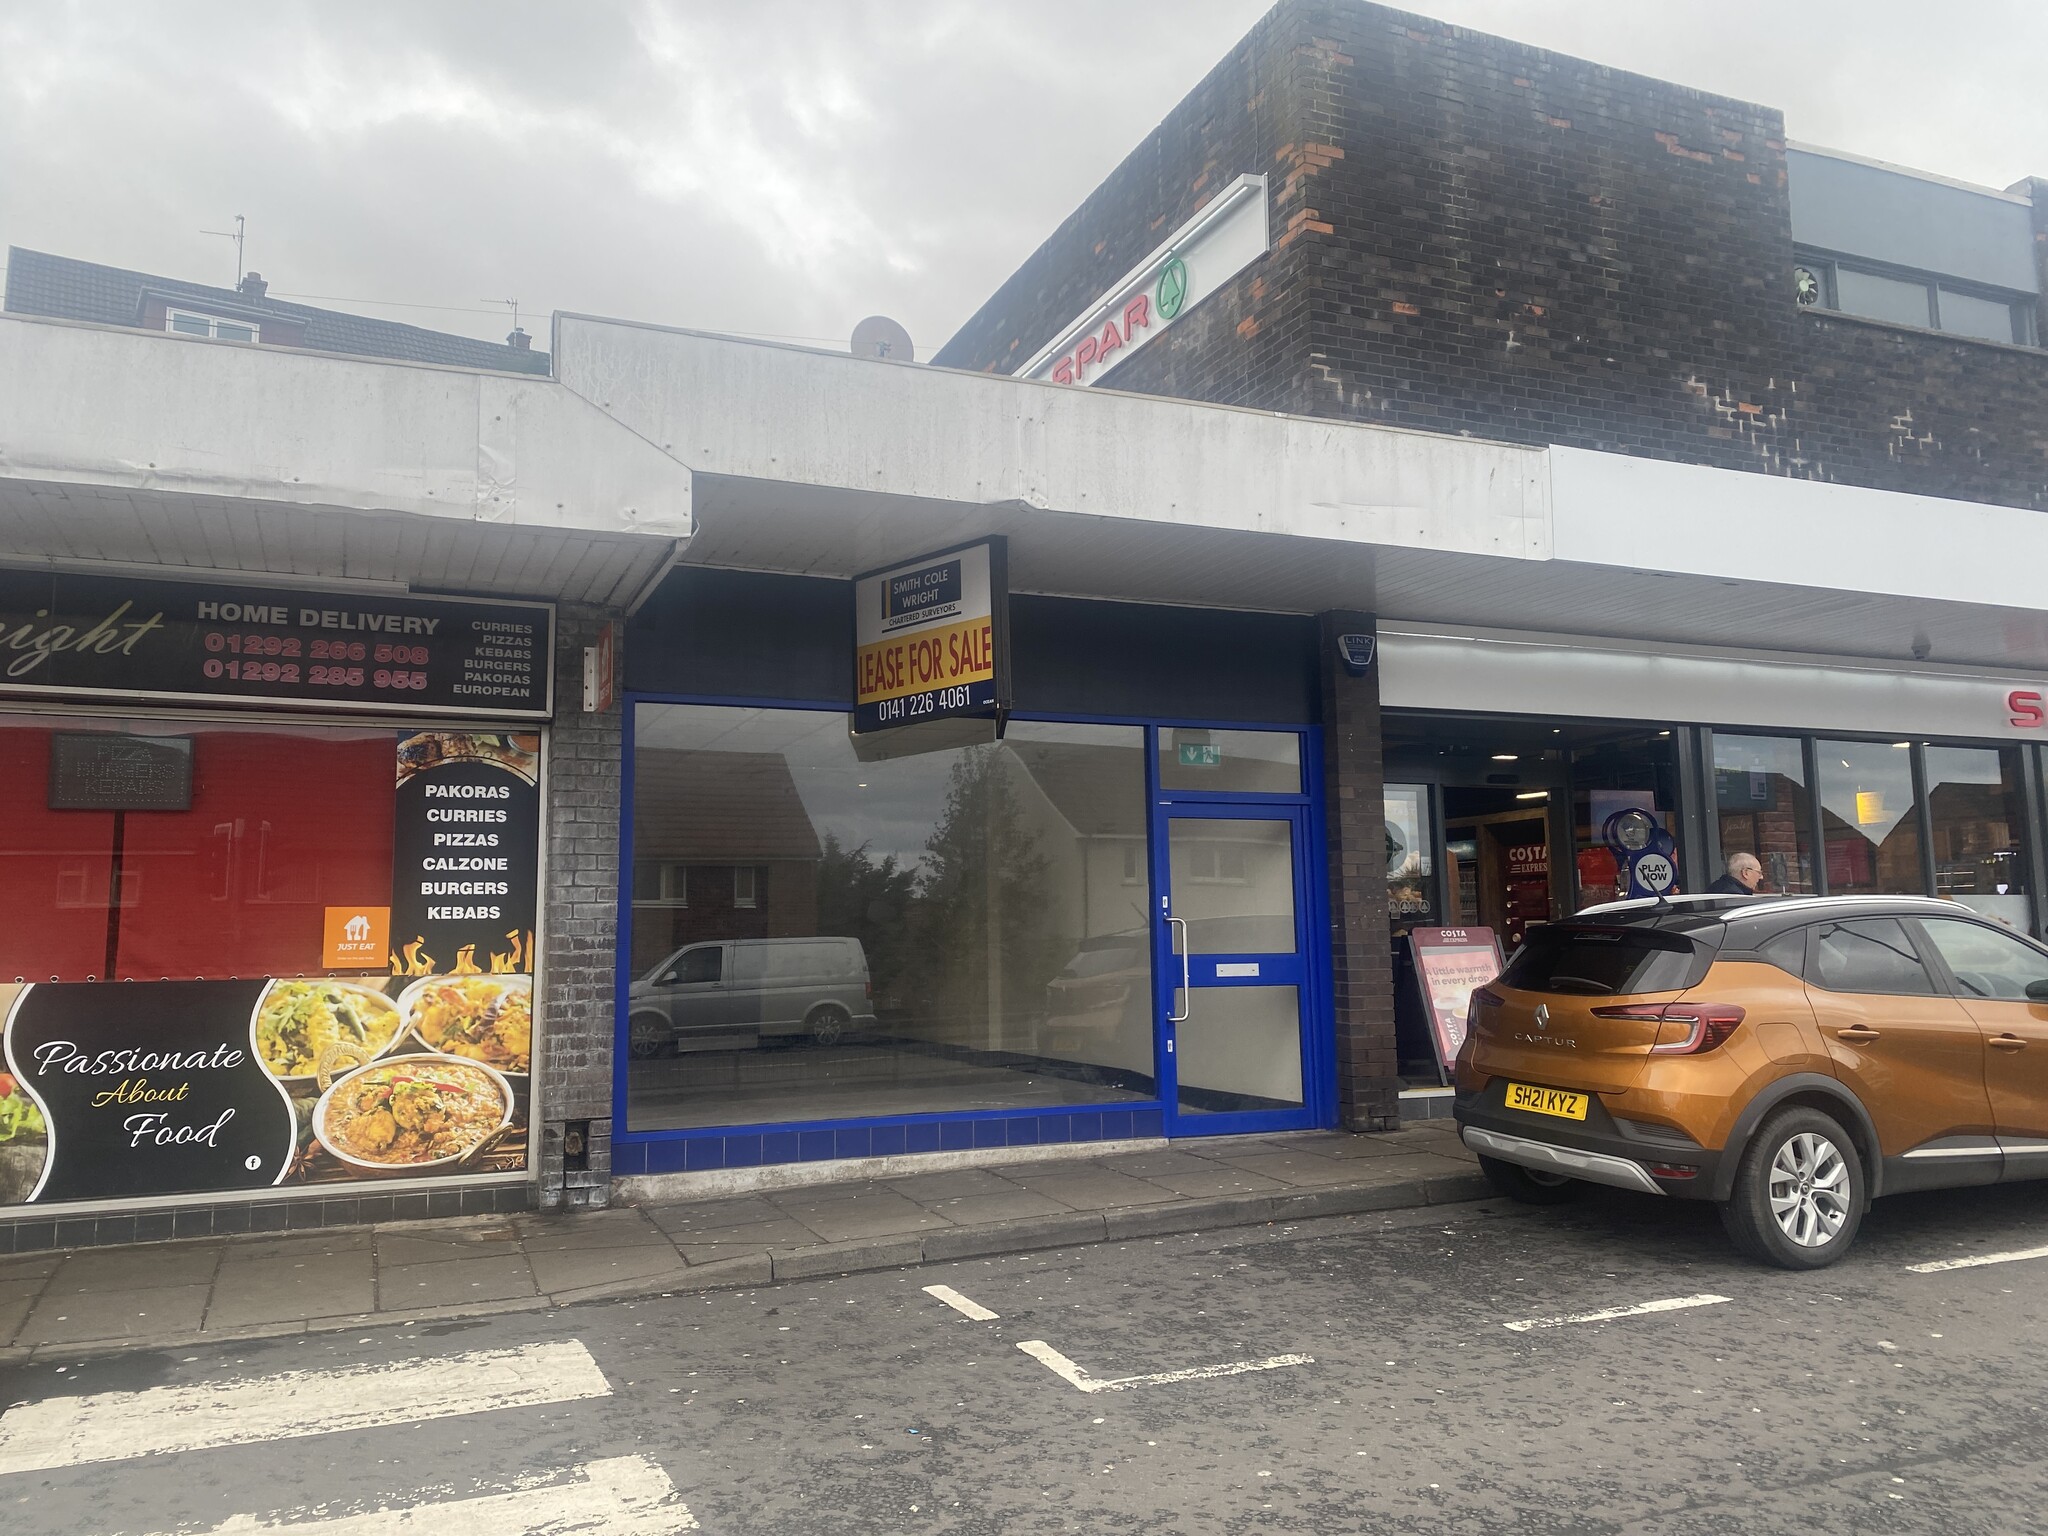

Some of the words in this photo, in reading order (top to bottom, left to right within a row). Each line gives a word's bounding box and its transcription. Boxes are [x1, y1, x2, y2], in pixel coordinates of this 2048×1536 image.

[1052, 294, 1148, 385] SPAR
[893, 575, 921, 595] SMITH
[924, 569, 949, 586] COLE
[902, 588, 939, 609] WRIGHT
[197, 601, 289, 625] HOME
[299, 608, 440, 635] DELIVERY
[888, 612, 920, 627] CHARTERED
[922, 603, 956, 619] SURVEYORS
[471, 621, 533, 634] CURRIES
[0, 600, 164, 676] ight
[482, 634, 532, 647] PIZZAS
[1345, 637, 1371, 645] LINK
[204, 632, 302, 657] 01292
[309, 639, 366, 662] 266
[373, 643, 429, 665] 508
[475, 646, 532, 660] KEBABS
[464, 659, 531, 672] BURGERS
[859, 646, 904, 695] LEASE
[909, 637, 945, 685] FOR
[949, 625, 992, 678] SALE
[203, 658, 300, 683] 01292
[308, 665, 365, 687] 285
[373, 669, 428, 690] 955
[464, 671, 531, 685] PAKORAS
[452, 684, 530, 697] EUROPEAN
[878, 698, 905, 721] 0141
[909, 691, 934, 716] 226
[938, 685, 971, 710] 4061
[76, 761, 176, 779] BURGERS
[425, 784, 510, 799] PAKORAS
[426, 808, 507, 823] CURRIES
[433, 833, 499, 847] PIZZAS
[422, 857, 508, 871] CALZONE
[1521, 862, 1548, 873] EXPRES
[1641, 864, 1667, 872] PLAY
[1642, 872, 1667, 881] NOW
[421, 882, 509, 895] BURGERS
[427, 906, 501, 920] KEBABS
[1440, 930, 1467, 938] COSTA
[337, 943, 358, 951] JUST
[1425, 968, 1432, 976] A
[1432, 966, 1455, 976] little
[1457, 963, 1492, 974] warmth
[1431, 977, 1441, 986] in
[1441, 976, 1466, 986] every
[1468, 974, 1490, 984] drop
[1444, 1017, 1459, 1046] COSTA
[1514, 1032, 1577, 1048] CAPTUR
[33, 1040, 245, 1076] Passionate
[91, 1078, 190, 1108] About
[1514, 1086, 1545, 1108] SH21
[1547, 1091, 1578, 1114] KYZ
[123, 1107, 236, 1148] Food
